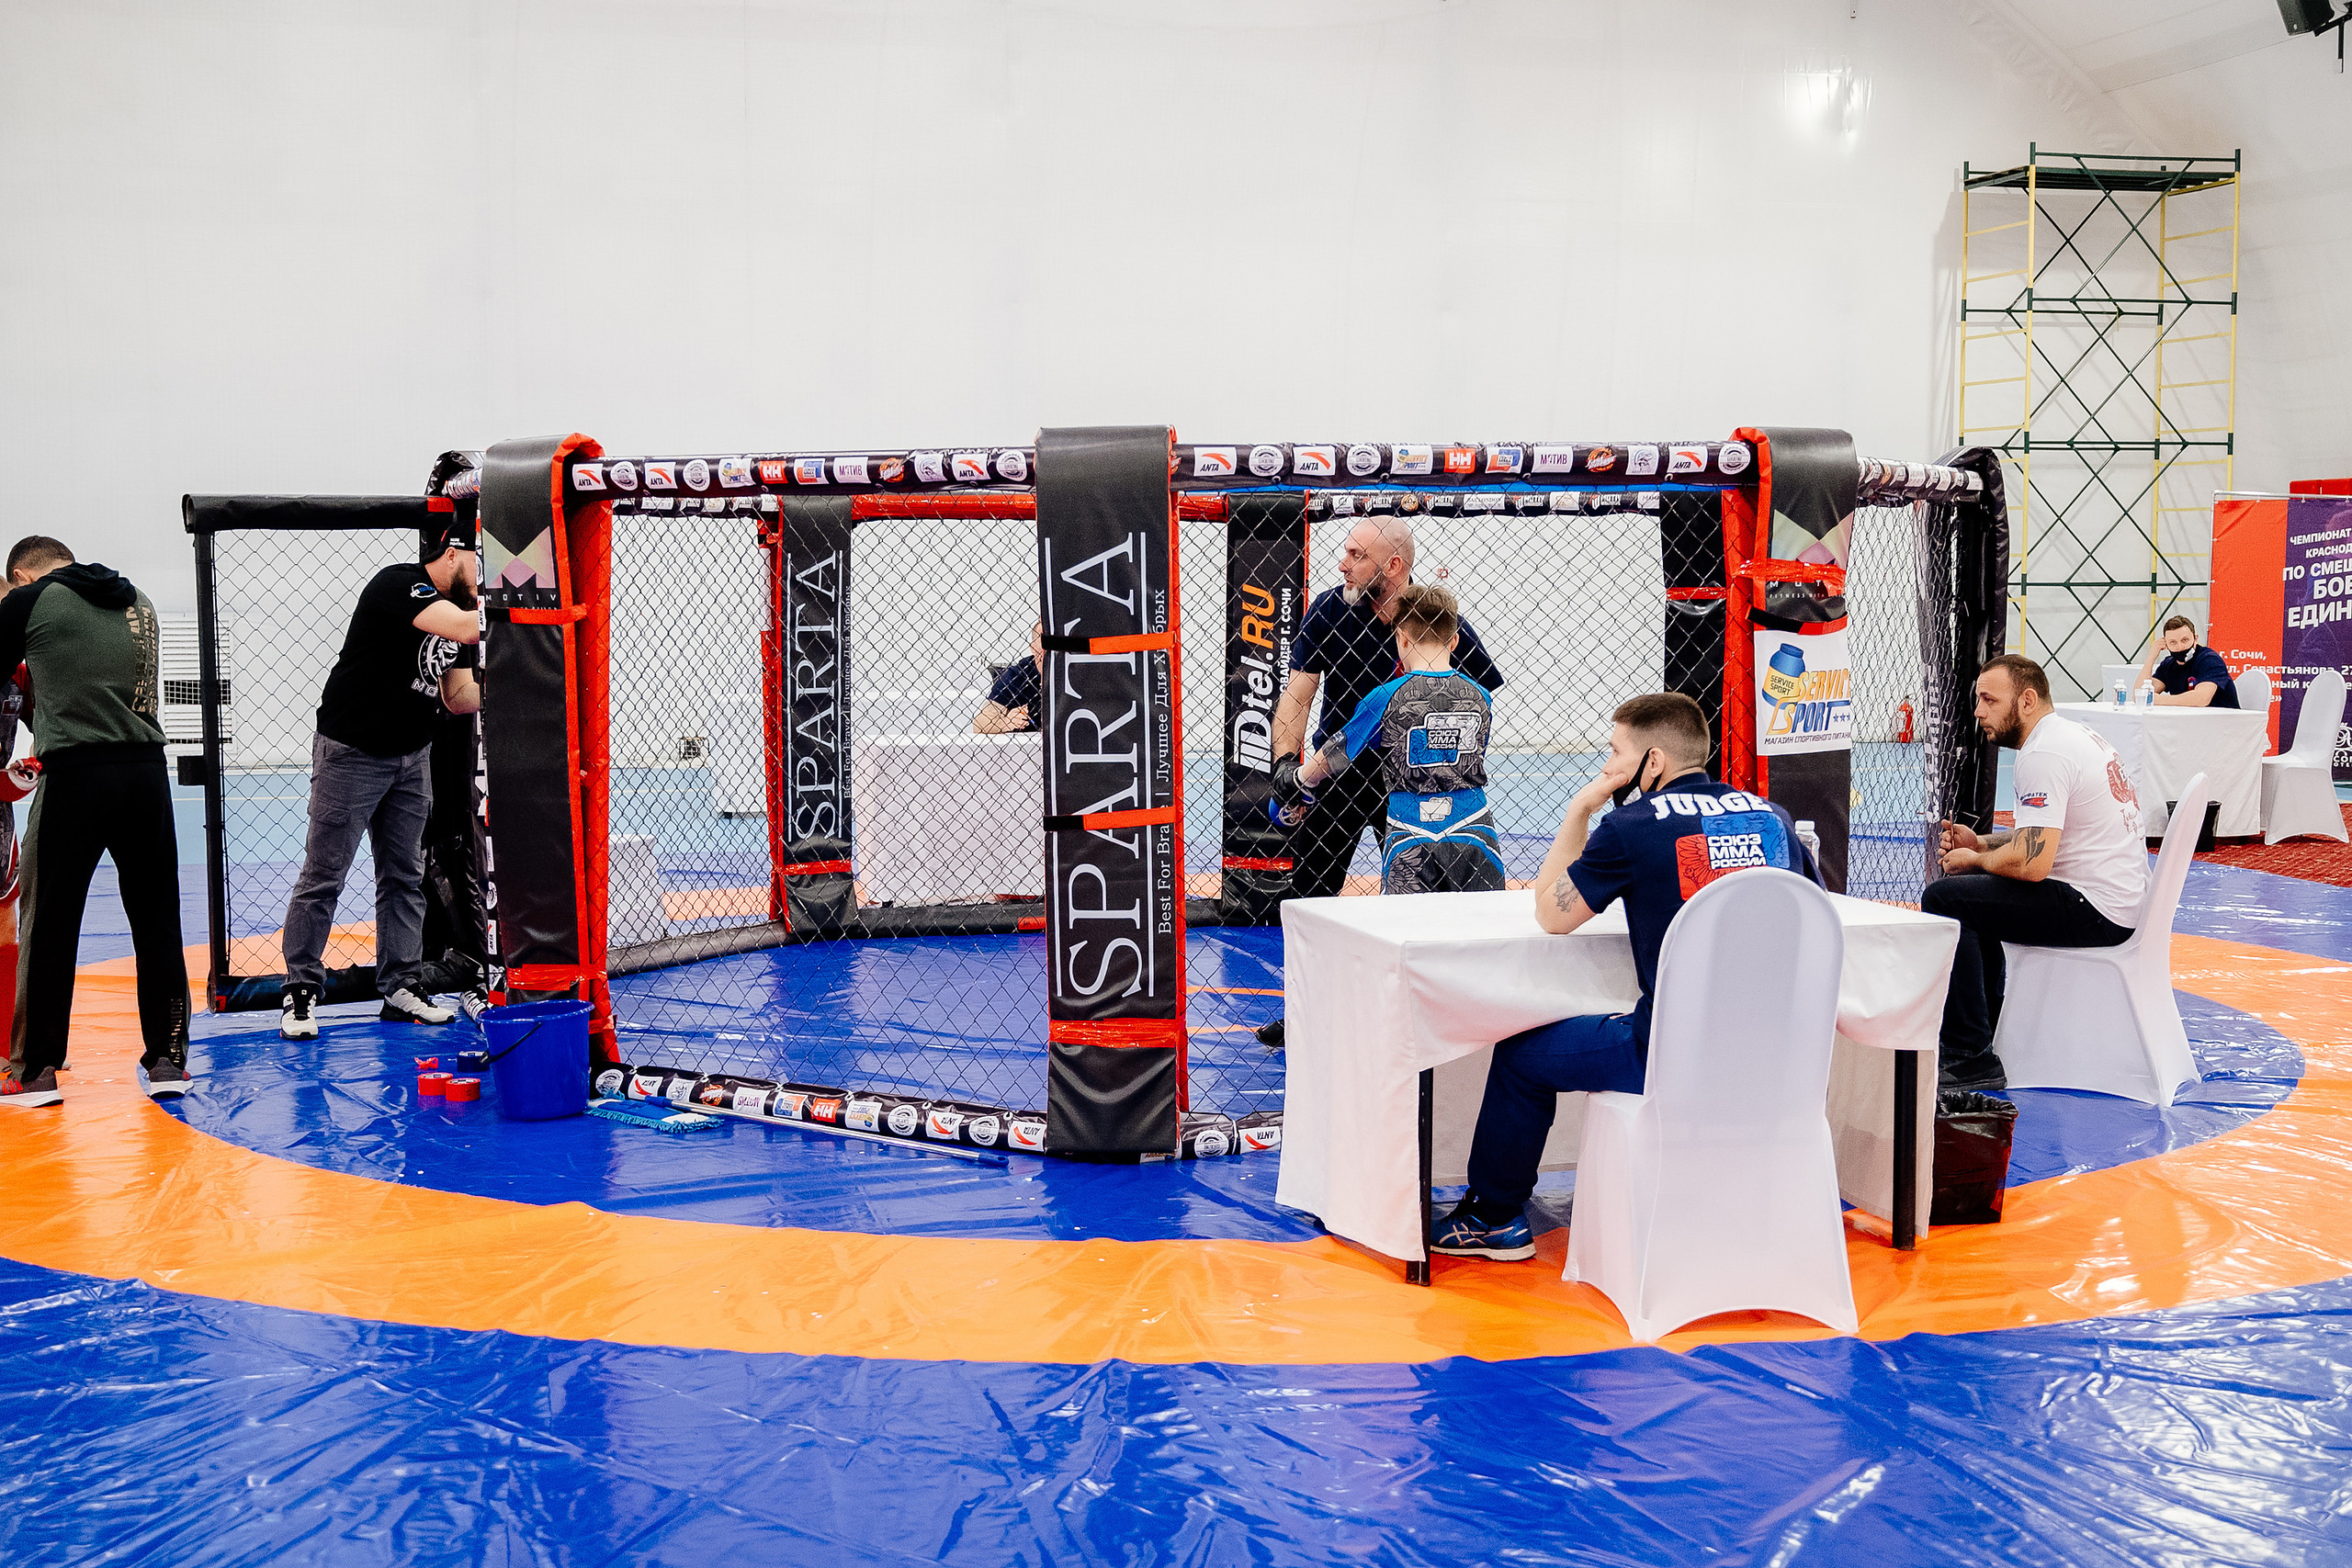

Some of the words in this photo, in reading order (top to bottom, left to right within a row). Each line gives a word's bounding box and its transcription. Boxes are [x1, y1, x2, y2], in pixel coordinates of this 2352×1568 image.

[1199, 463, 1219, 472] ANTA
[1299, 462, 1318, 471] ANTA
[1673, 461, 1691, 469] ANTA
[959, 469, 976, 478] ANTA
[578, 478, 593, 487] ANTA
[650, 478, 664, 486] ANTA
[2290, 527, 2352, 546] ЧЕМПИОНАТ
[2305, 542, 2352, 558] КРАСНОД
[2282, 565, 2305, 581] ПО
[1281, 588, 1292, 623] СОЧИ
[2288, 599, 2352, 629] ЕДИН
[1152, 589, 1168, 665] Хбрых
[2231, 649, 2267, 660] Сочи,
[1154, 671, 1170, 707] Для
[1770, 674, 1795, 691] SERVICE
[1770, 682, 1792, 696] SPORT
[795, 550, 836, 840] SPARTA
[1767, 699, 1850, 736] SPORT
[1429, 736, 1457, 744] ММА
[1764, 737, 1794, 745] МАГАЗИН
[1794, 733, 1832, 743] СПОРТИВНОГО
[1156, 713, 1170, 783] Лучшее
[1060, 532, 1142, 998] SPARTA
[1649, 791, 1773, 821] JUDGE
[1157, 805, 1170, 855] Bra
[1707, 833, 1762, 847] СОЮЗ
[1709, 845, 1764, 861] ММА
[1711, 856, 1767, 871] РОССИИ
[1158, 860, 1171, 890] For
[1158, 896, 1171, 934] Best
